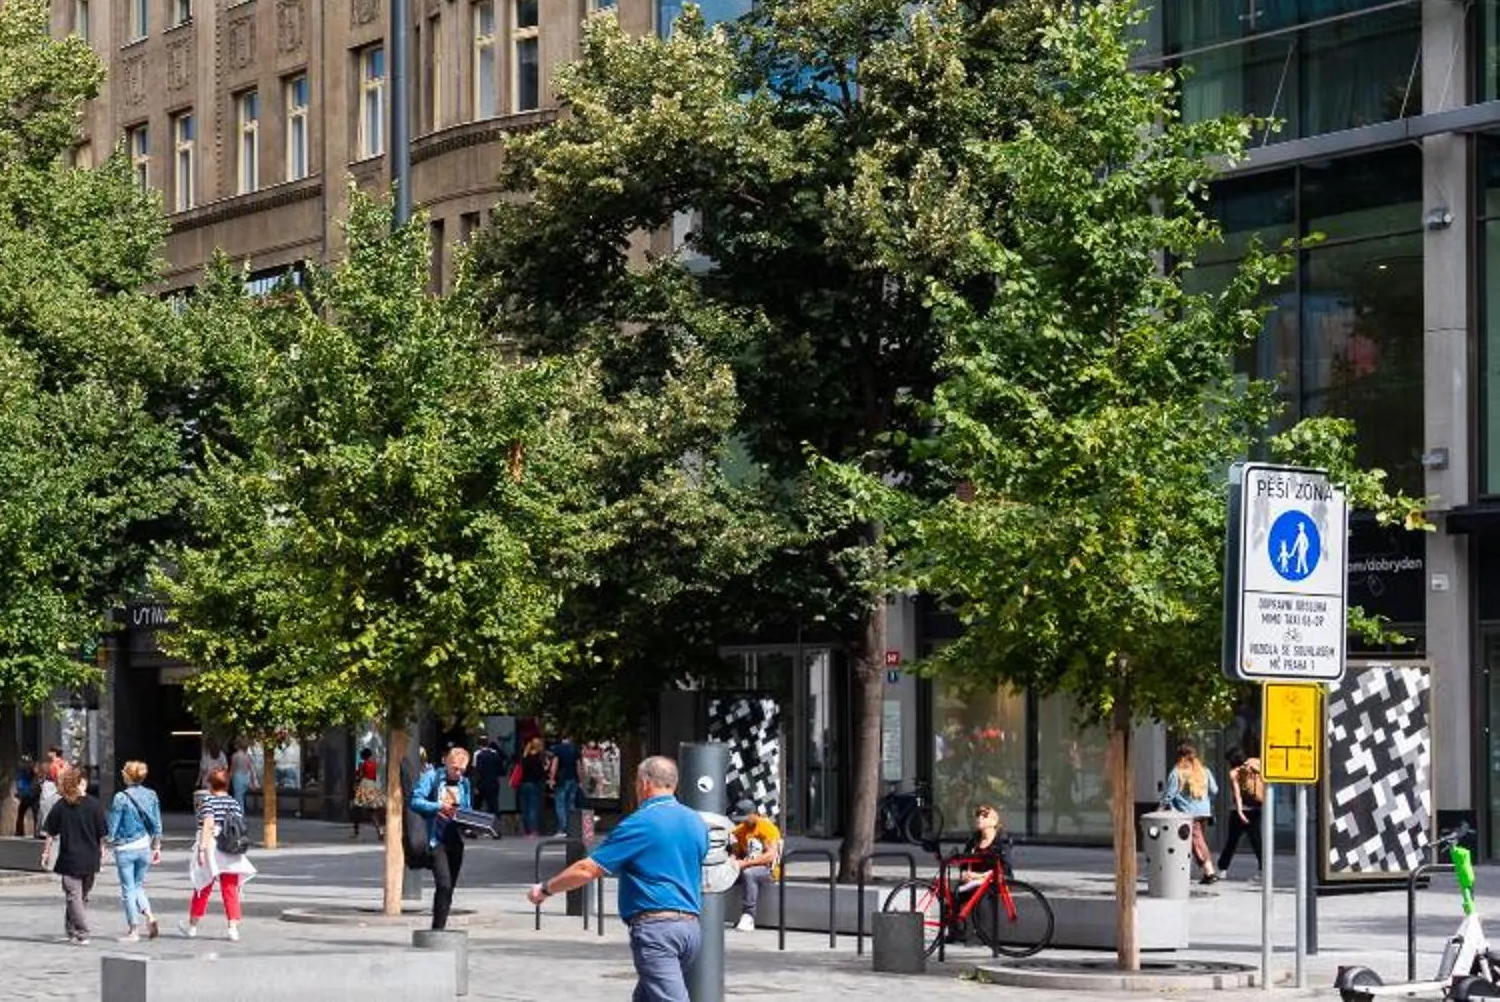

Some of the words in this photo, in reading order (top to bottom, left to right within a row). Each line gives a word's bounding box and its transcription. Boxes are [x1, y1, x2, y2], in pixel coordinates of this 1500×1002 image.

[1257, 476, 1289, 499] PĚŠÍ
[1296, 479, 1334, 502] ZÓNA
[1281, 644, 1291, 656] SE
[1283, 659, 1307, 671] PRAHA
